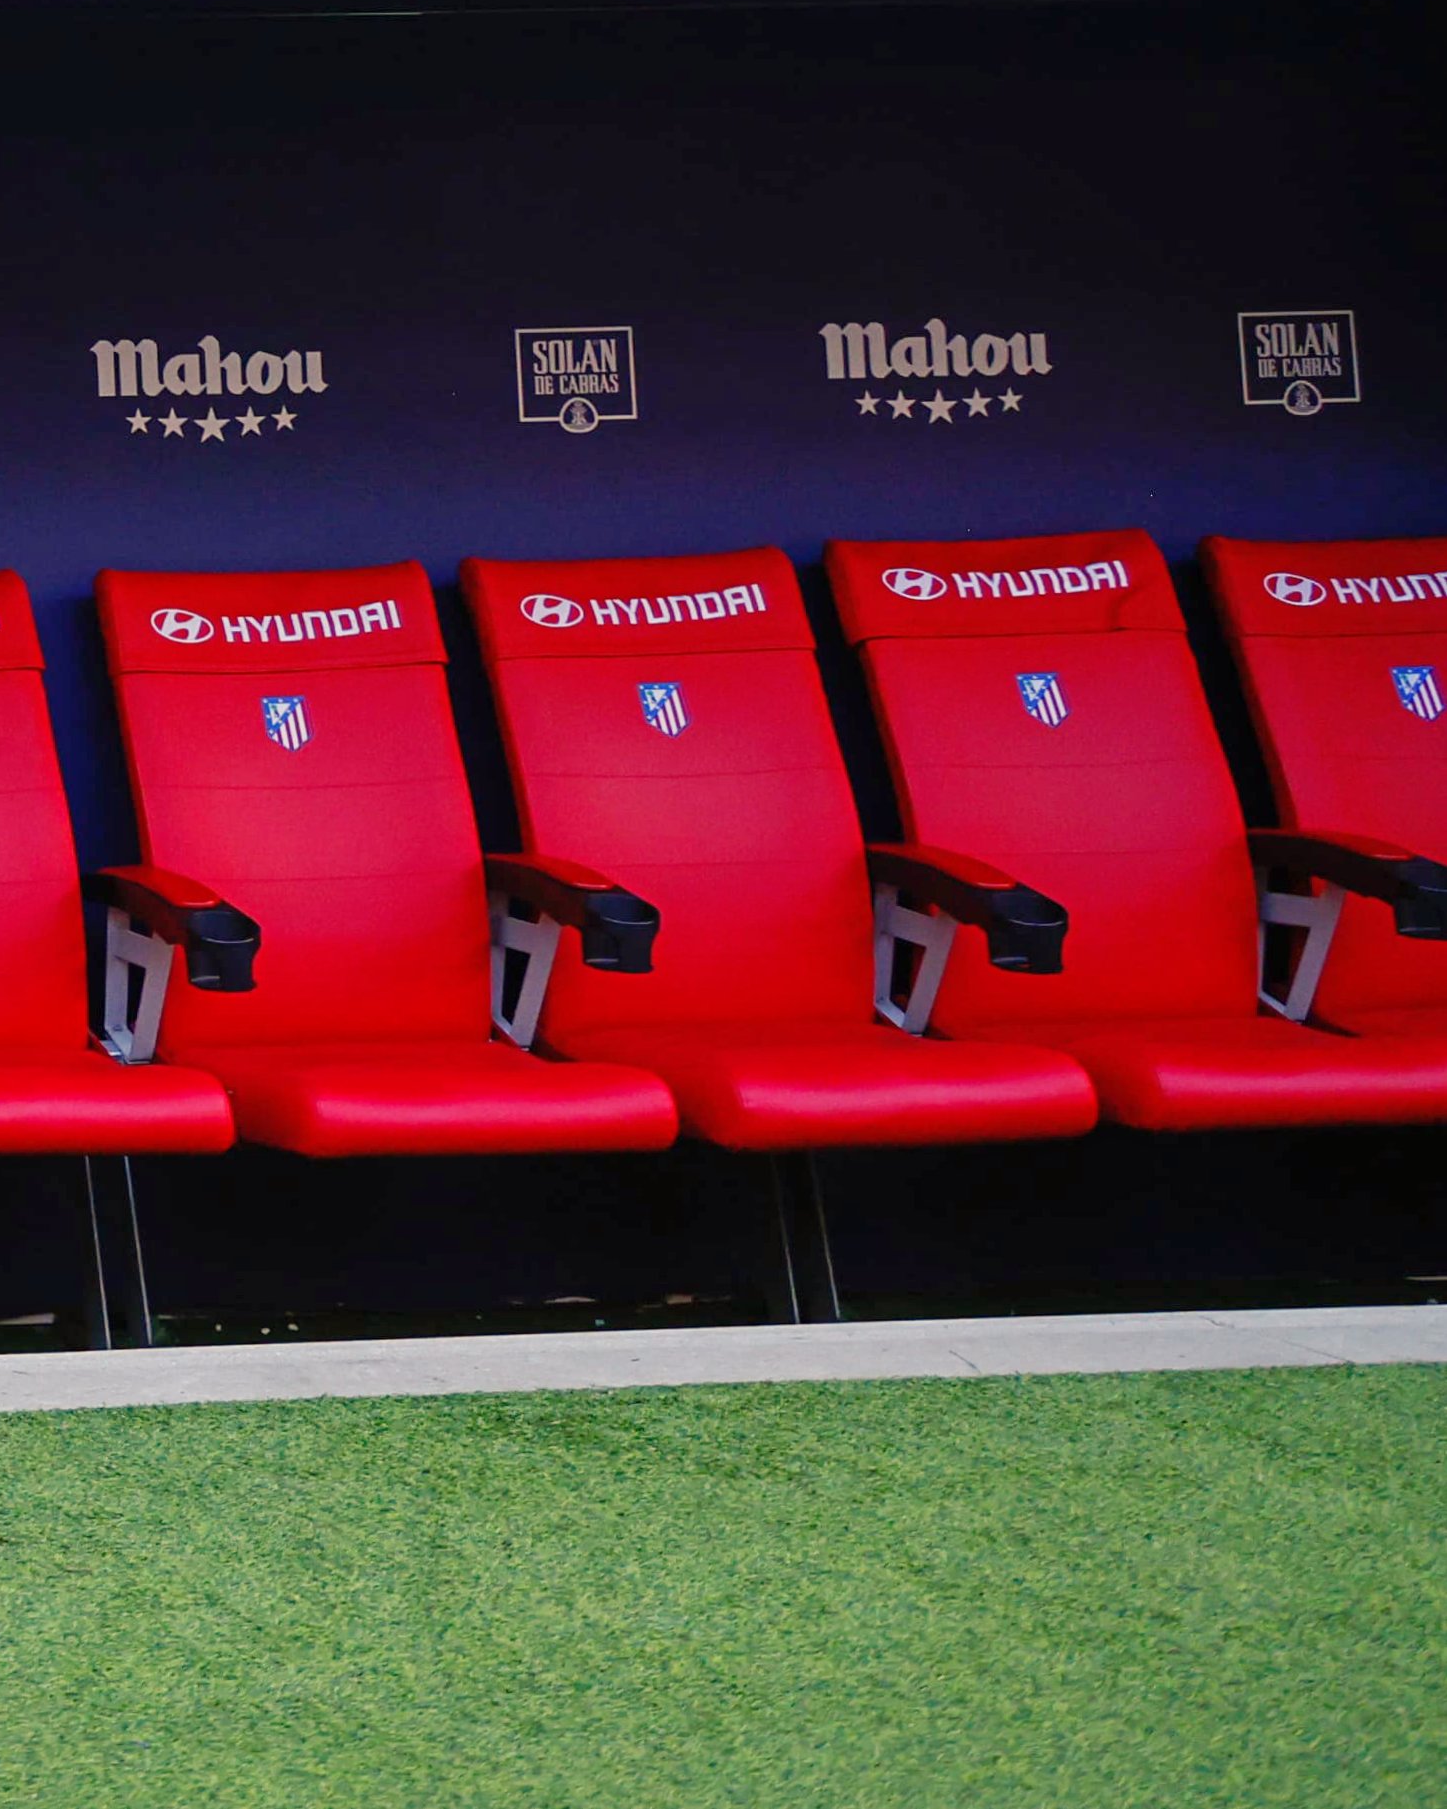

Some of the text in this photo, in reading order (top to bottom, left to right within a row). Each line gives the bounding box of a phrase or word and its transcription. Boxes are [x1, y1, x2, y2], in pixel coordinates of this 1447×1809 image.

[533, 339, 616, 374] SOLAN
[819, 319, 1052, 379] Mahou
[1256, 323, 1338, 357] SOLAN
[90, 336, 328, 397] Mahou
[535, 374, 618, 395] DE CABRAS
[1259, 358, 1341, 377] DE CABRAS
[952, 561, 1127, 597] HYUNDAI
[222, 600, 400, 642] HYUNDAI
[590, 584, 765, 624] HYUNDAI
